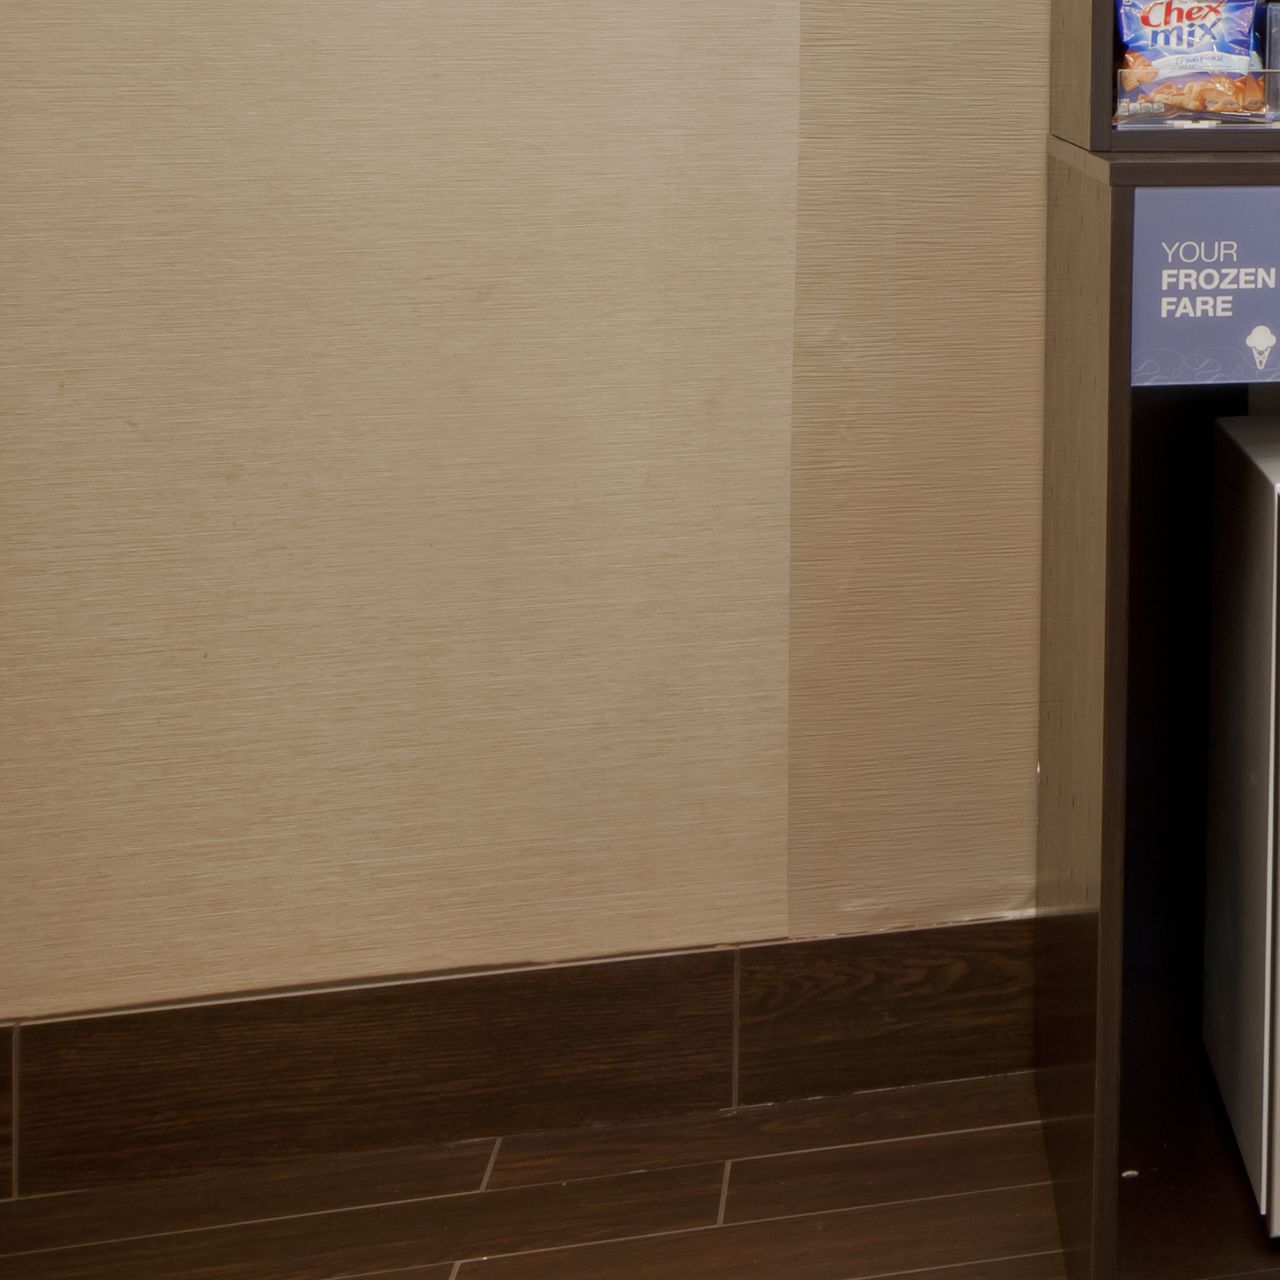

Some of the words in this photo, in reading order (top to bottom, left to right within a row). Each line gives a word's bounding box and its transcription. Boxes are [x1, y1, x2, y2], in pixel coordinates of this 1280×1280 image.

[1151, 18, 1222, 49] mix
[1161, 241, 1237, 263] YOUR
[1161, 268, 1276, 290] FROZEN
[1161, 296, 1233, 318] FARE
